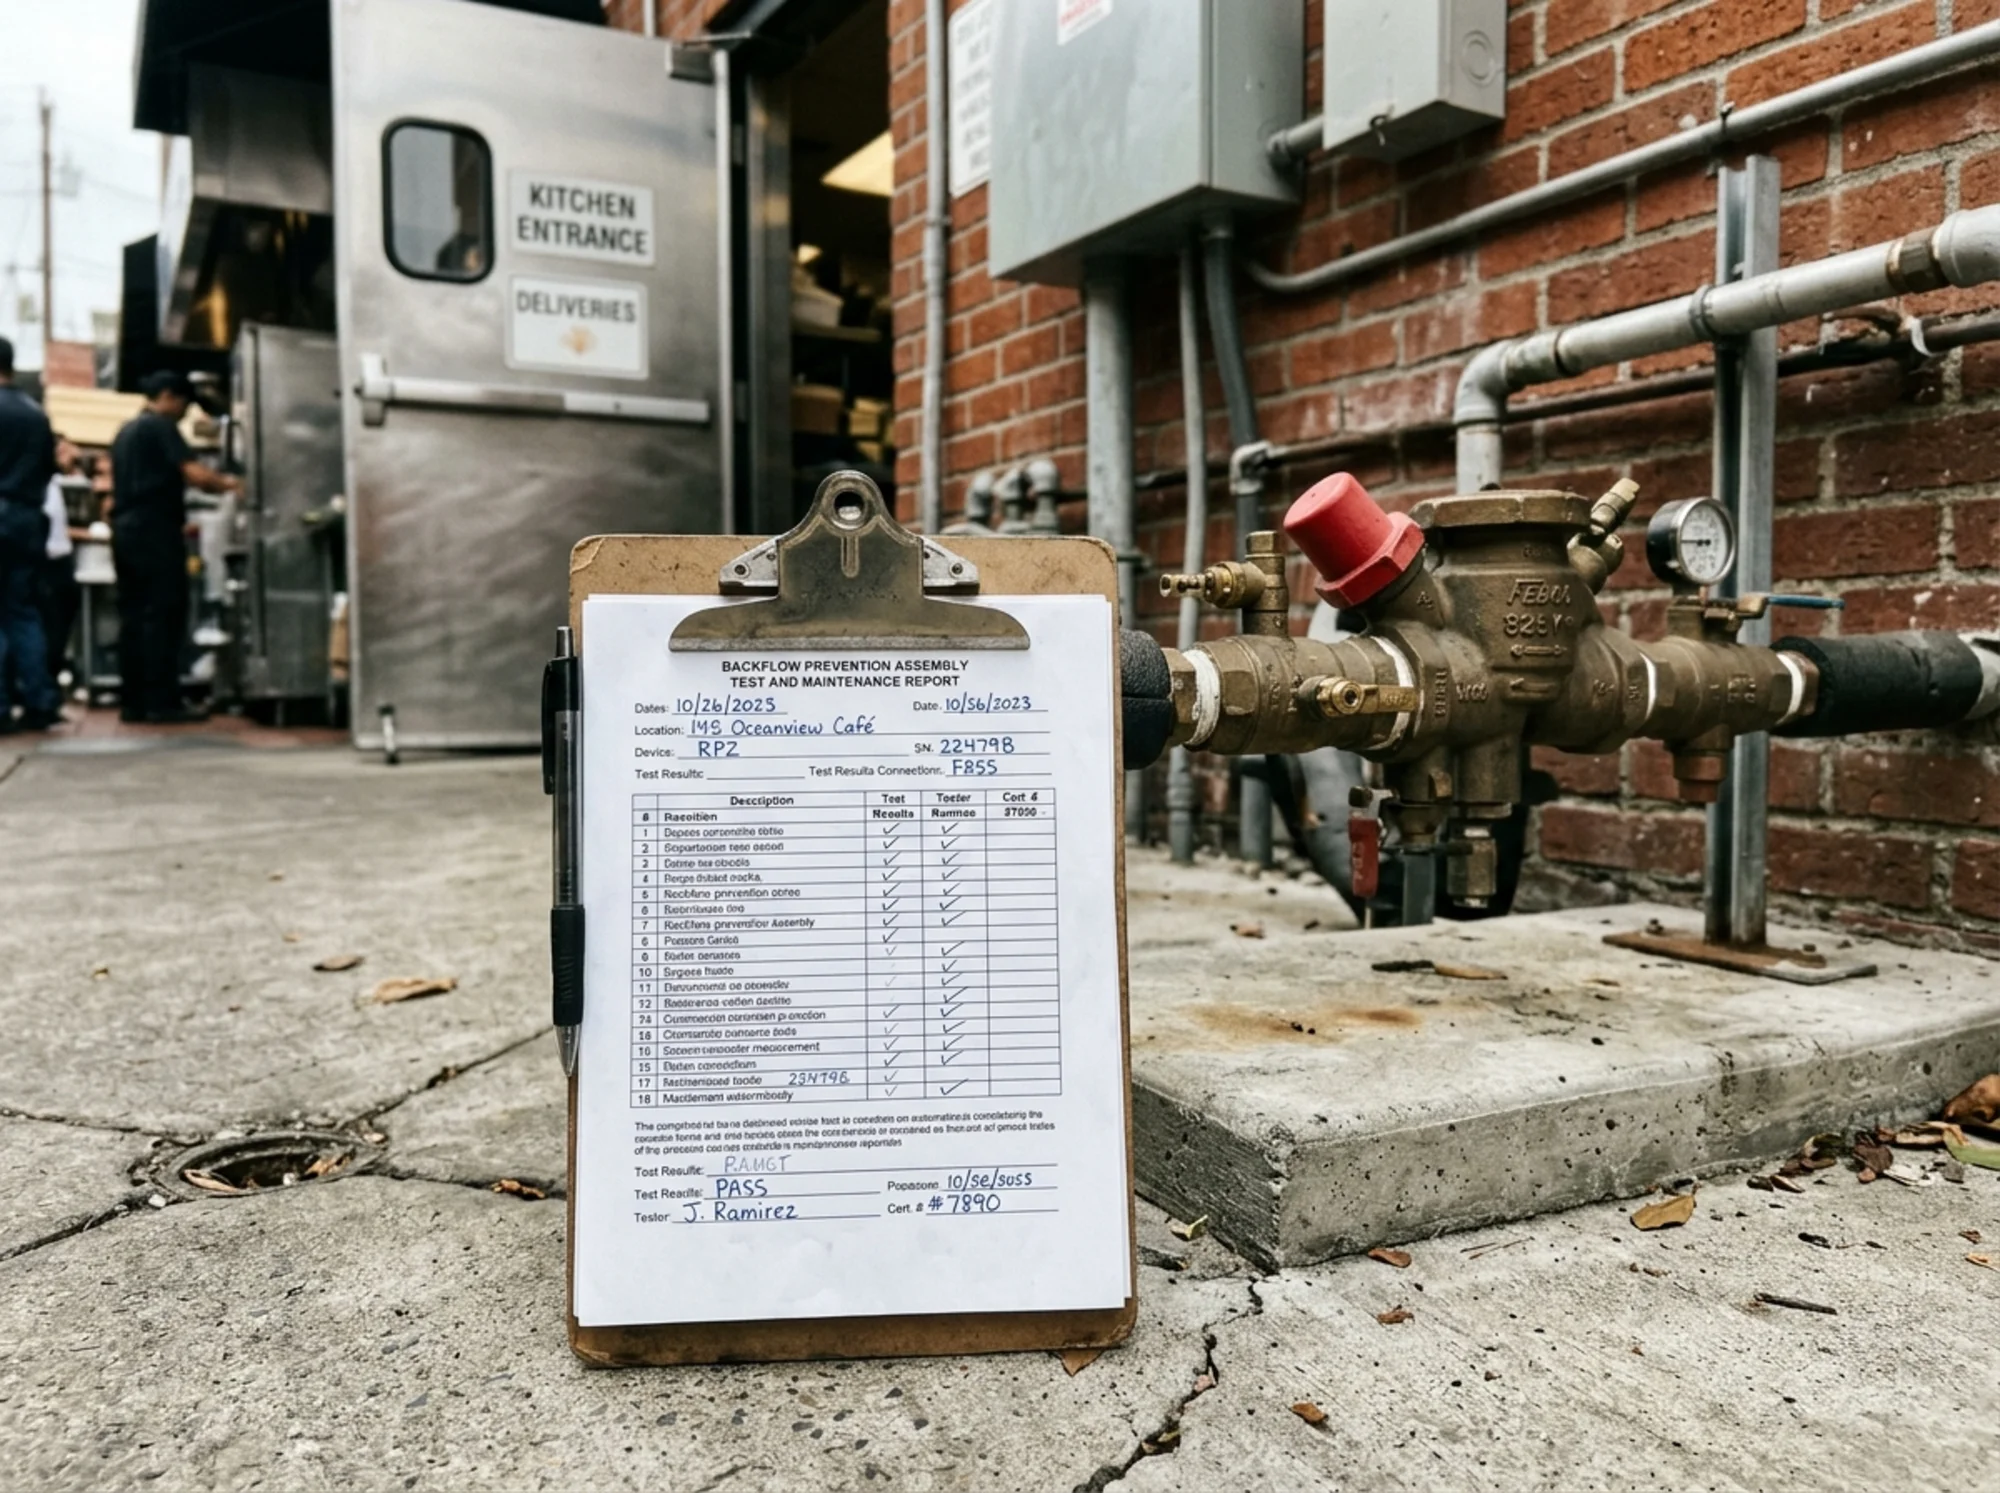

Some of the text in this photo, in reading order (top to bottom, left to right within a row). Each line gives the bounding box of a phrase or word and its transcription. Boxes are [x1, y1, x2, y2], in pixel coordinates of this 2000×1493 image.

[530, 182, 636, 220] KITCHEN
[517, 215, 649, 256] ENTRANCE
[516, 289, 637, 324] DELIVERIES
[722, 659, 969, 673] BACKFLOW PREVENTION ASSEMBLY
[730, 675, 960, 688] TEST AND MAINTENANCE REPORT
[635, 725, 685, 736] Location:
[731, 719, 824, 736] Oceanview
[833, 714, 877, 736] Café
[698, 740, 741, 758] RPZ
[635, 769, 659, 779] Test
[809, 766, 833, 776] Test
[639, 967, 652, 977] 10
[639, 1078, 651, 1088] 17
[715, 1178, 769, 1199] PASS
[714, 1200, 799, 1221] Ramirez
